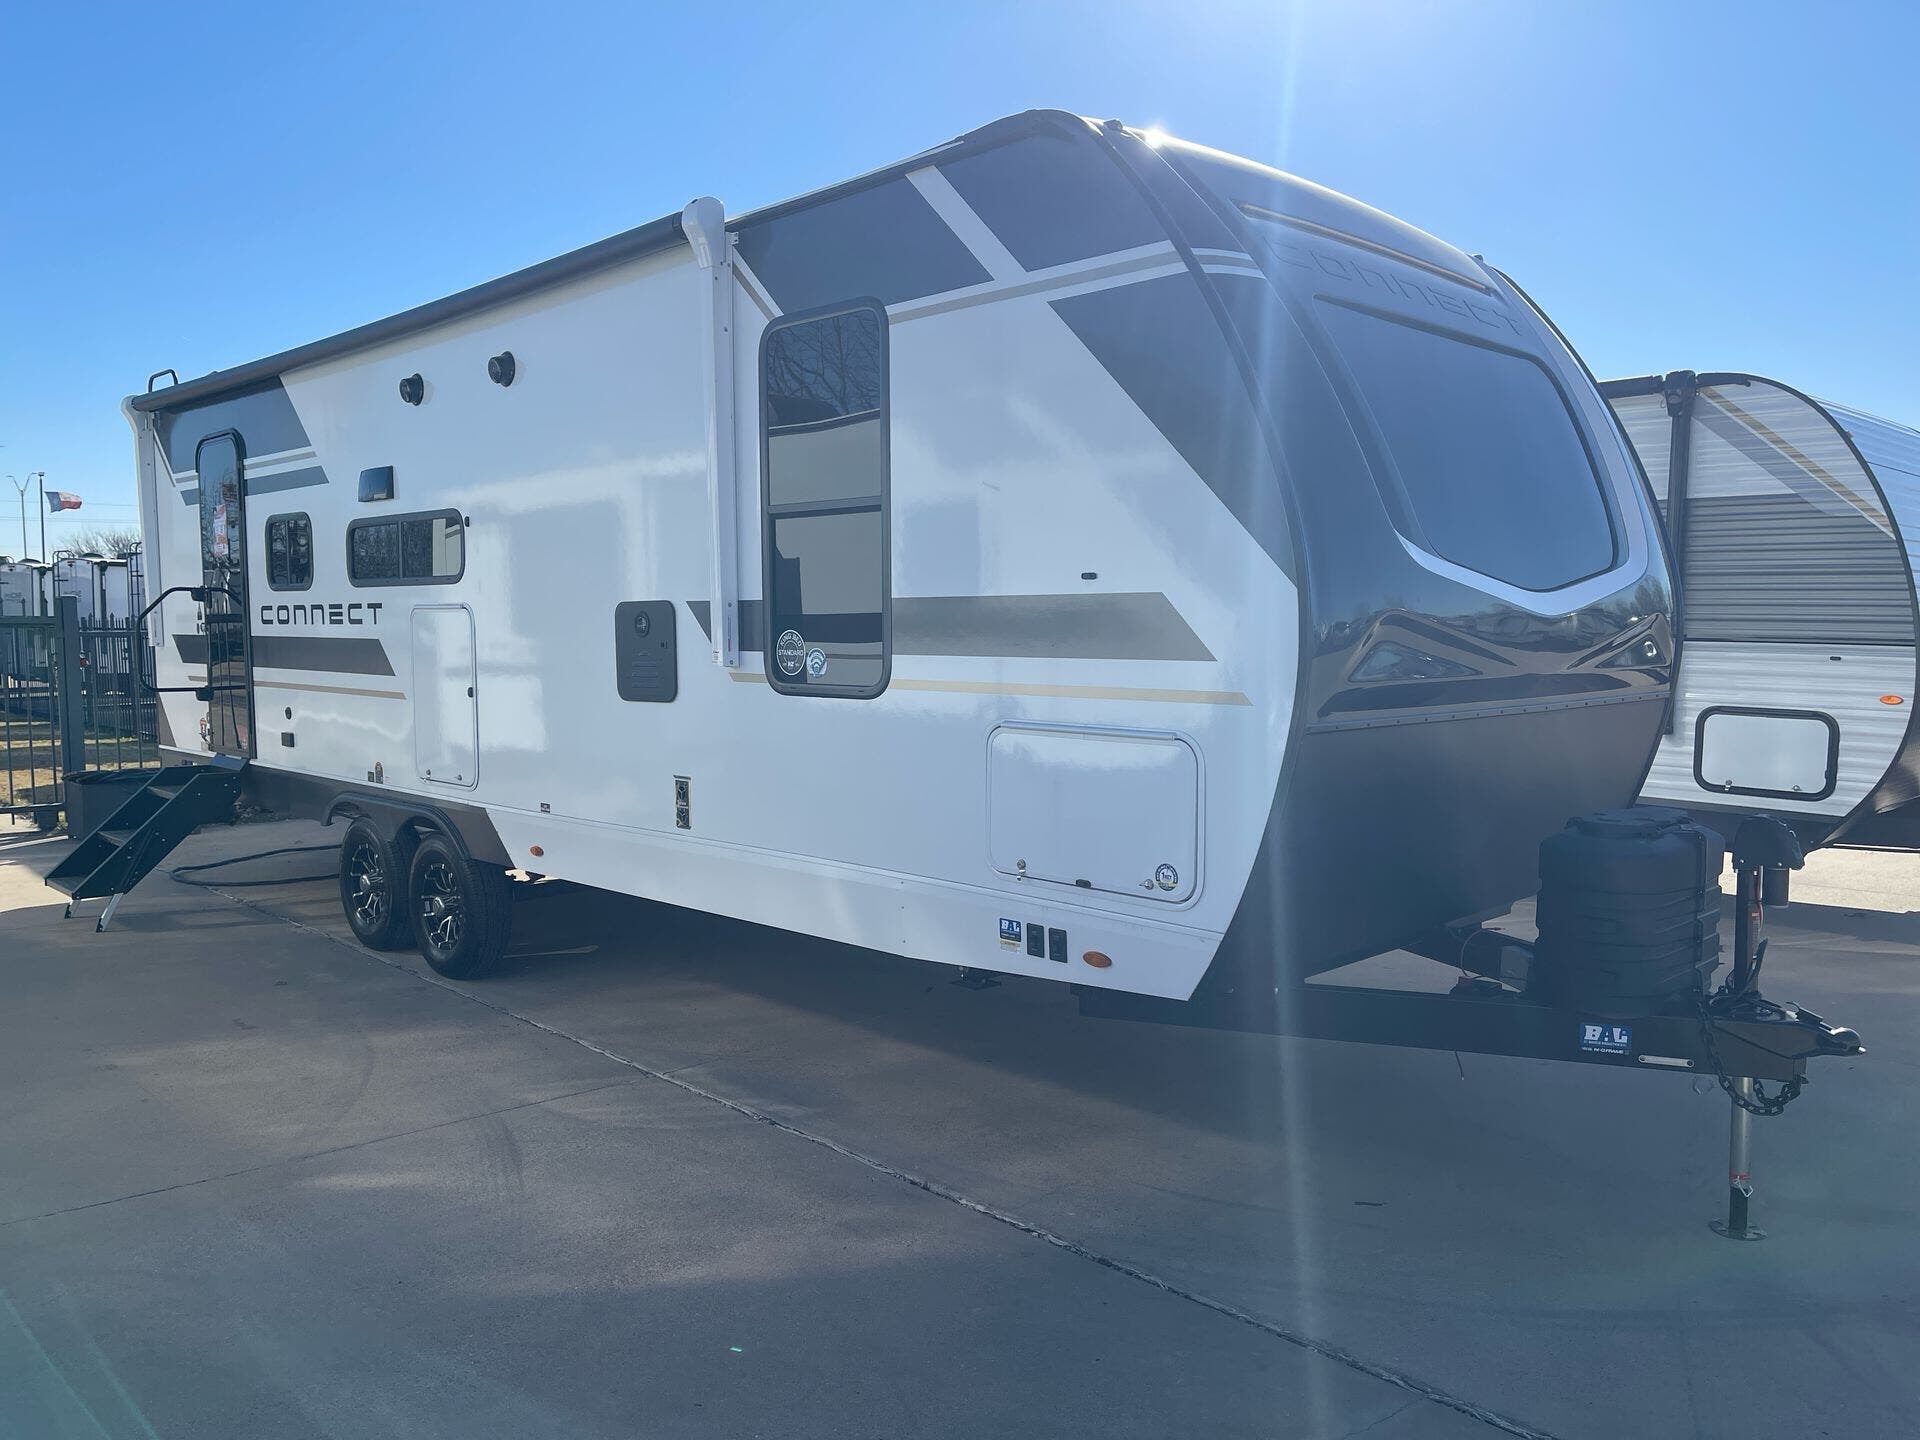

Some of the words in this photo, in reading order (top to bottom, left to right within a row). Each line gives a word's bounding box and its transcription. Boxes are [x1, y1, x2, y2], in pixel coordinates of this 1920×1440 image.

[1262, 236, 1523, 337] CONNECT
[260, 602, 383, 625] CONNECT
[779, 632, 792, 647] KING
[792, 633, 803, 647] BED
[1583, 1025, 1628, 1044] BAL
